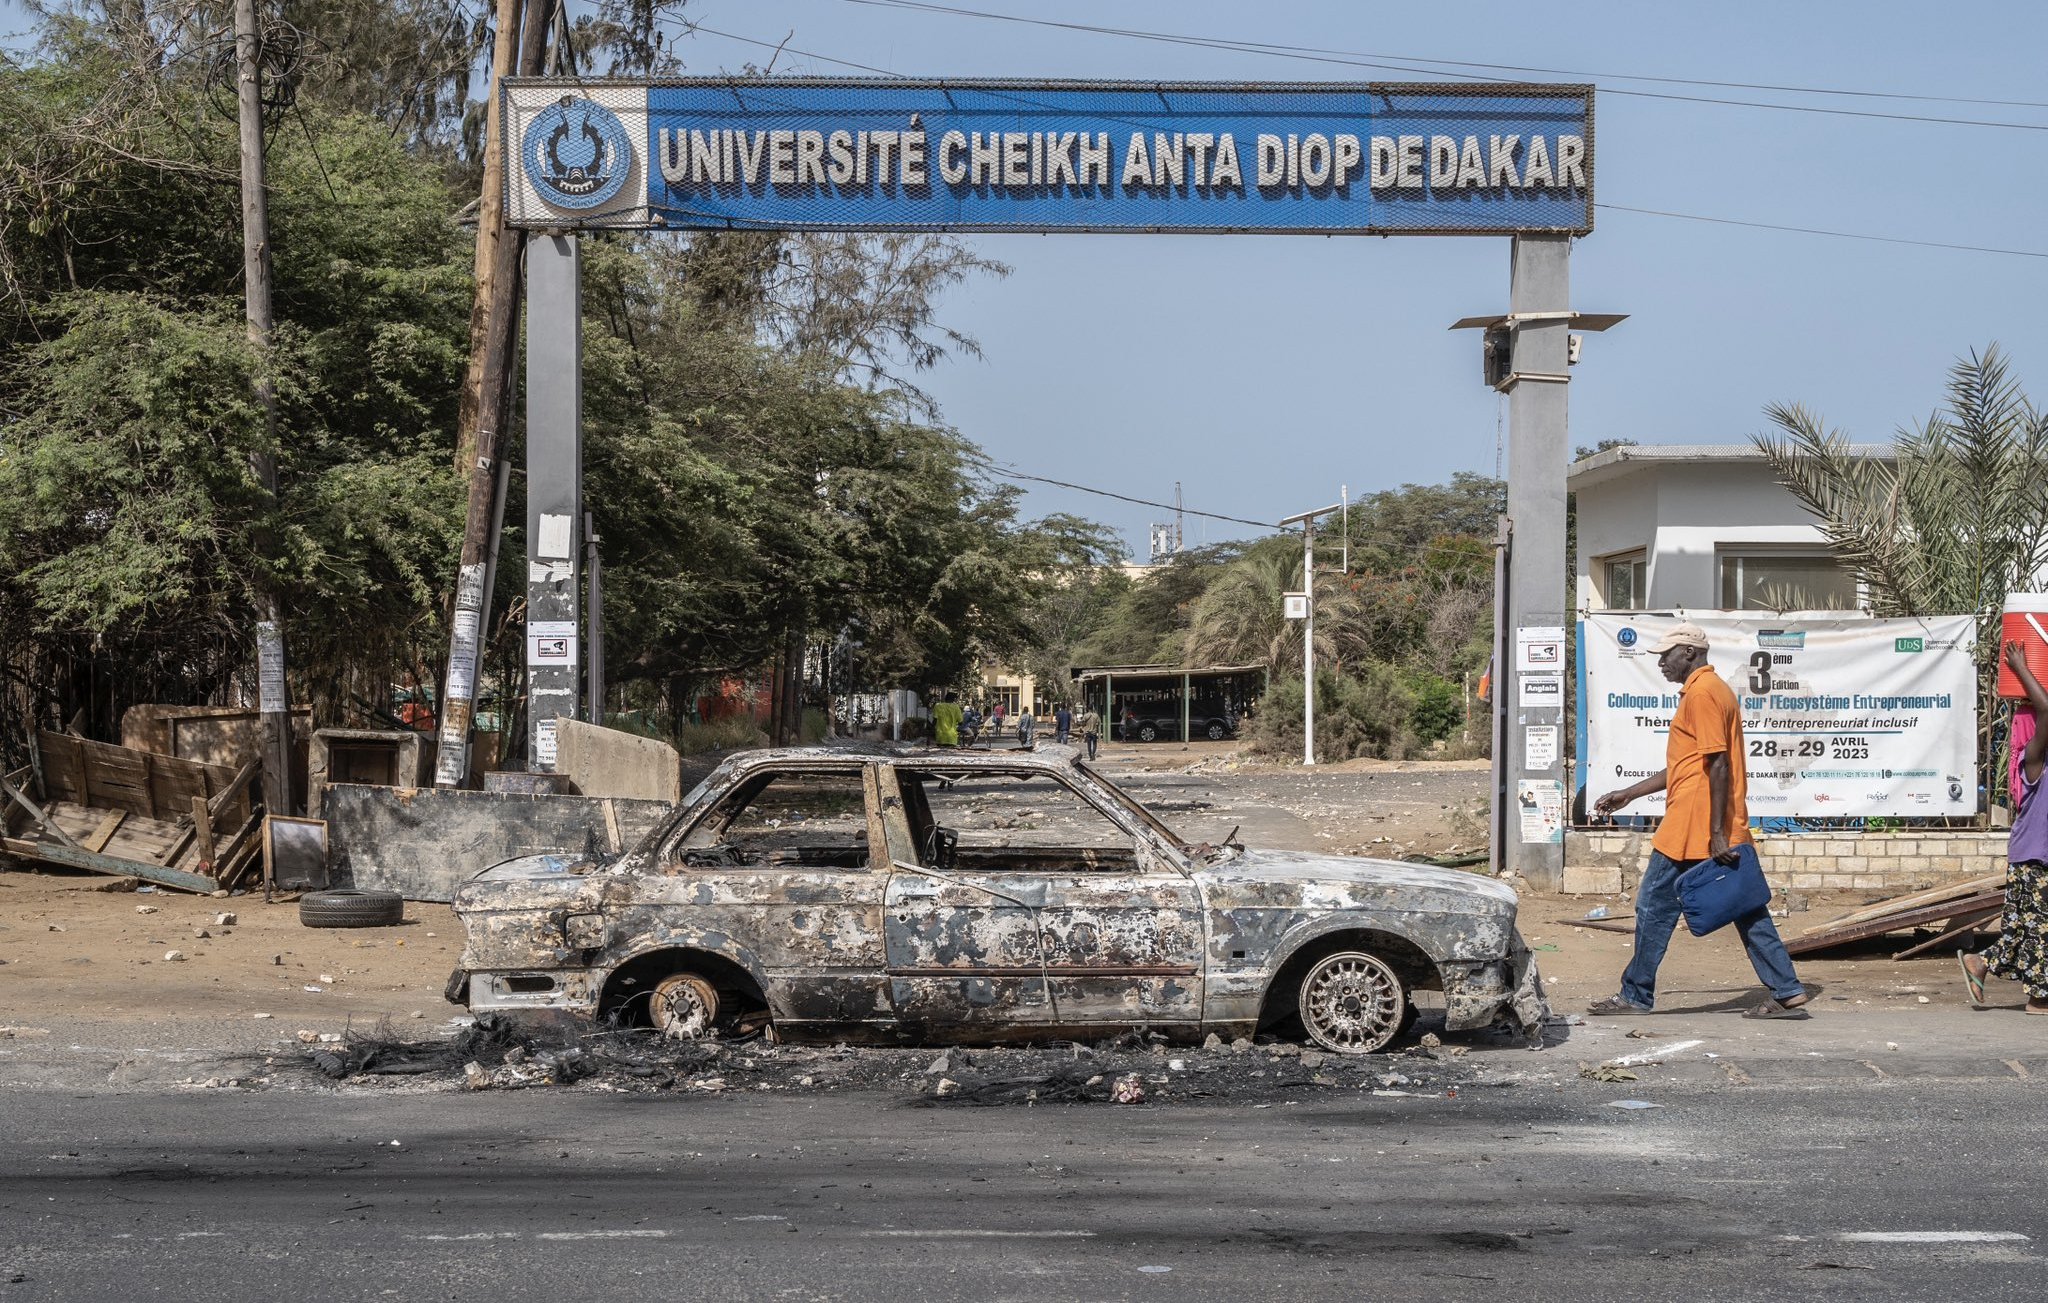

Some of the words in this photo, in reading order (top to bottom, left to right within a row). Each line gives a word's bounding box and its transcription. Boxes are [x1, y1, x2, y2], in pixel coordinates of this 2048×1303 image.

[658, 113, 926, 185] UNIVERSITÉ
[938, 130, 1108, 185] CHEIKH
[1121, 132, 1242, 187] ANTA
[1256, 132, 1360, 188] DIOP
[1750, 651, 1772, 695] 3
[1773, 653, 1793, 664] ème
[1526, 684, 1557, 693] Anglais
[1772, 680, 1799, 690] Edition
[1608, 693, 1658, 710] Colloque
[1745, 697, 1766, 709] sur
[1854, 693, 1951, 711] Entrepreneurial
[1764, 717, 1868, 730] l'entrepreneuriat
[1872, 717, 1918, 728] inclusif
[1831, 737, 1868, 746] AVRIL
[1750, 740, 1777, 757] 28
[1781, 749, 1795, 757] ET
[1798, 740, 1825, 757] 29
[1833, 748, 1868, 759] 2023
